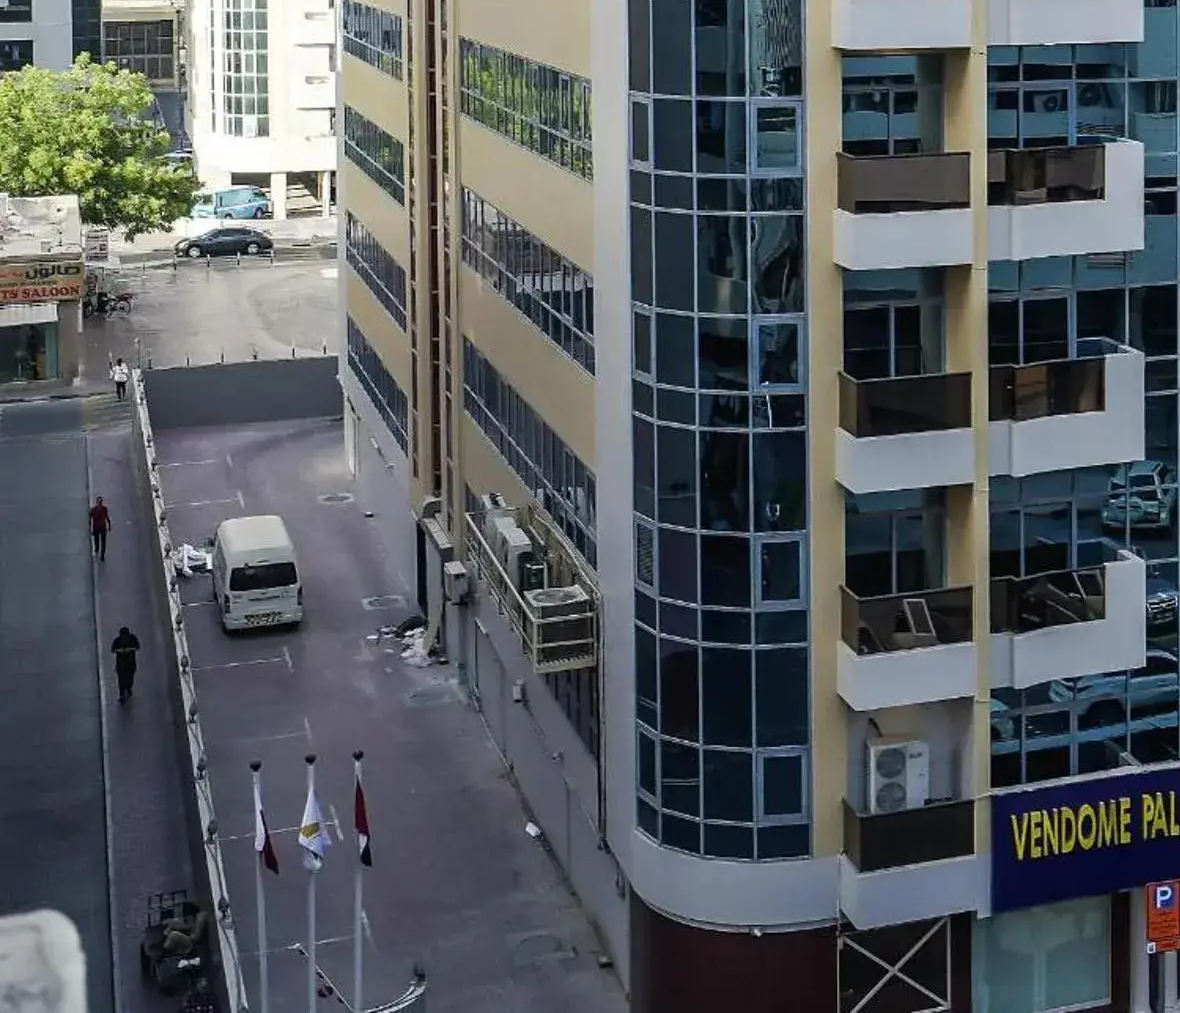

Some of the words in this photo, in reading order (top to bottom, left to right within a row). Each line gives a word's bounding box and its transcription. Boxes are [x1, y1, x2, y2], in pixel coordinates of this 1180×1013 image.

[21, 285, 80, 299] SALOON
[1010, 797, 1132, 861] VENDOME
[1156, 886, 1172, 909] P
